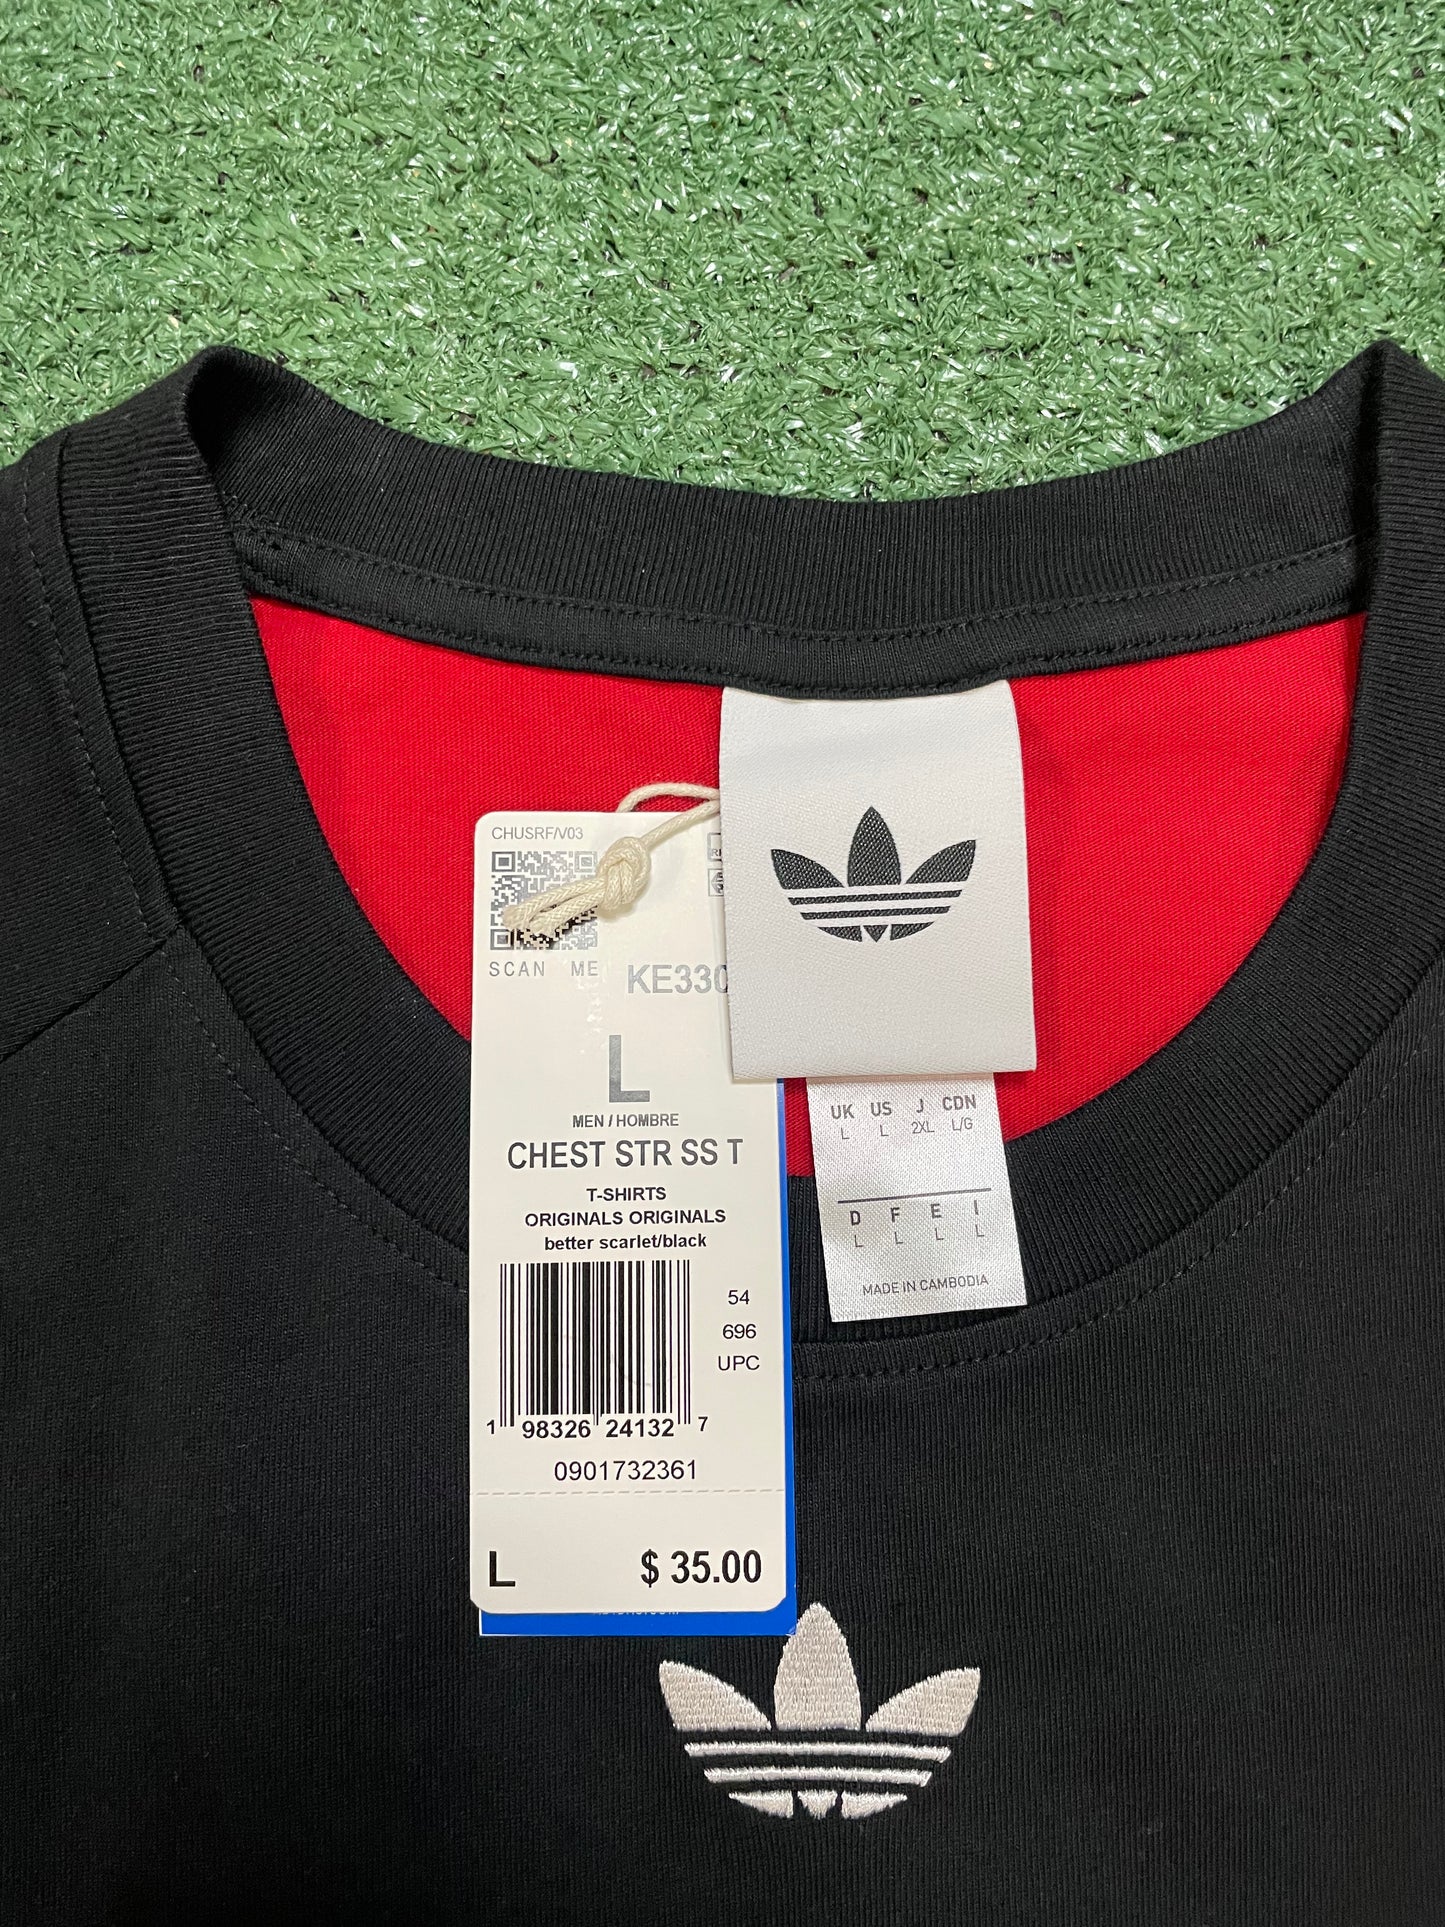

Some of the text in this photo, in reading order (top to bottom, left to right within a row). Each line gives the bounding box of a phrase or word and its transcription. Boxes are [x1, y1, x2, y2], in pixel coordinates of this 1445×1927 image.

[491, 827, 584, 840] CHUSRF/V03
[489, 960, 598, 977] SCAN ME
[609, 1034, 650, 1103] L
[830, 1094, 977, 1119] UK US J CDN
[572, 1114, 604, 1128] MEN
[616, 1113, 680, 1127] HOMBRE
[841, 1117, 973, 1140] L L 2XL L/G
[507, 1138, 743, 1169] CHEST STR SS T
[586, 1186, 667, 1202] T-SHIRTS
[524, 1209, 726, 1227] ORIGINALS ORIGINALS
[850, 1210, 861, 1226] D
[890, 1207, 900, 1223] F
[931, 1203, 942, 1219] E
[544, 1233, 707, 1250] better scarlet/black
[854, 1224, 985, 1248] L L L L
[862, 1274, 989, 1296] MADE IN CAMBODIA
[727, 1289, 750, 1305] 54
[722, 1324, 757, 1340] 696
[717, 1355, 760, 1371] UPC
[486, 1416, 708, 1439] 1 98326 24132 7
[554, 1459, 697, 1481] 0901732361
[489, 1551, 516, 1588] L
[640, 1548, 762, 1588] $ 35.00
